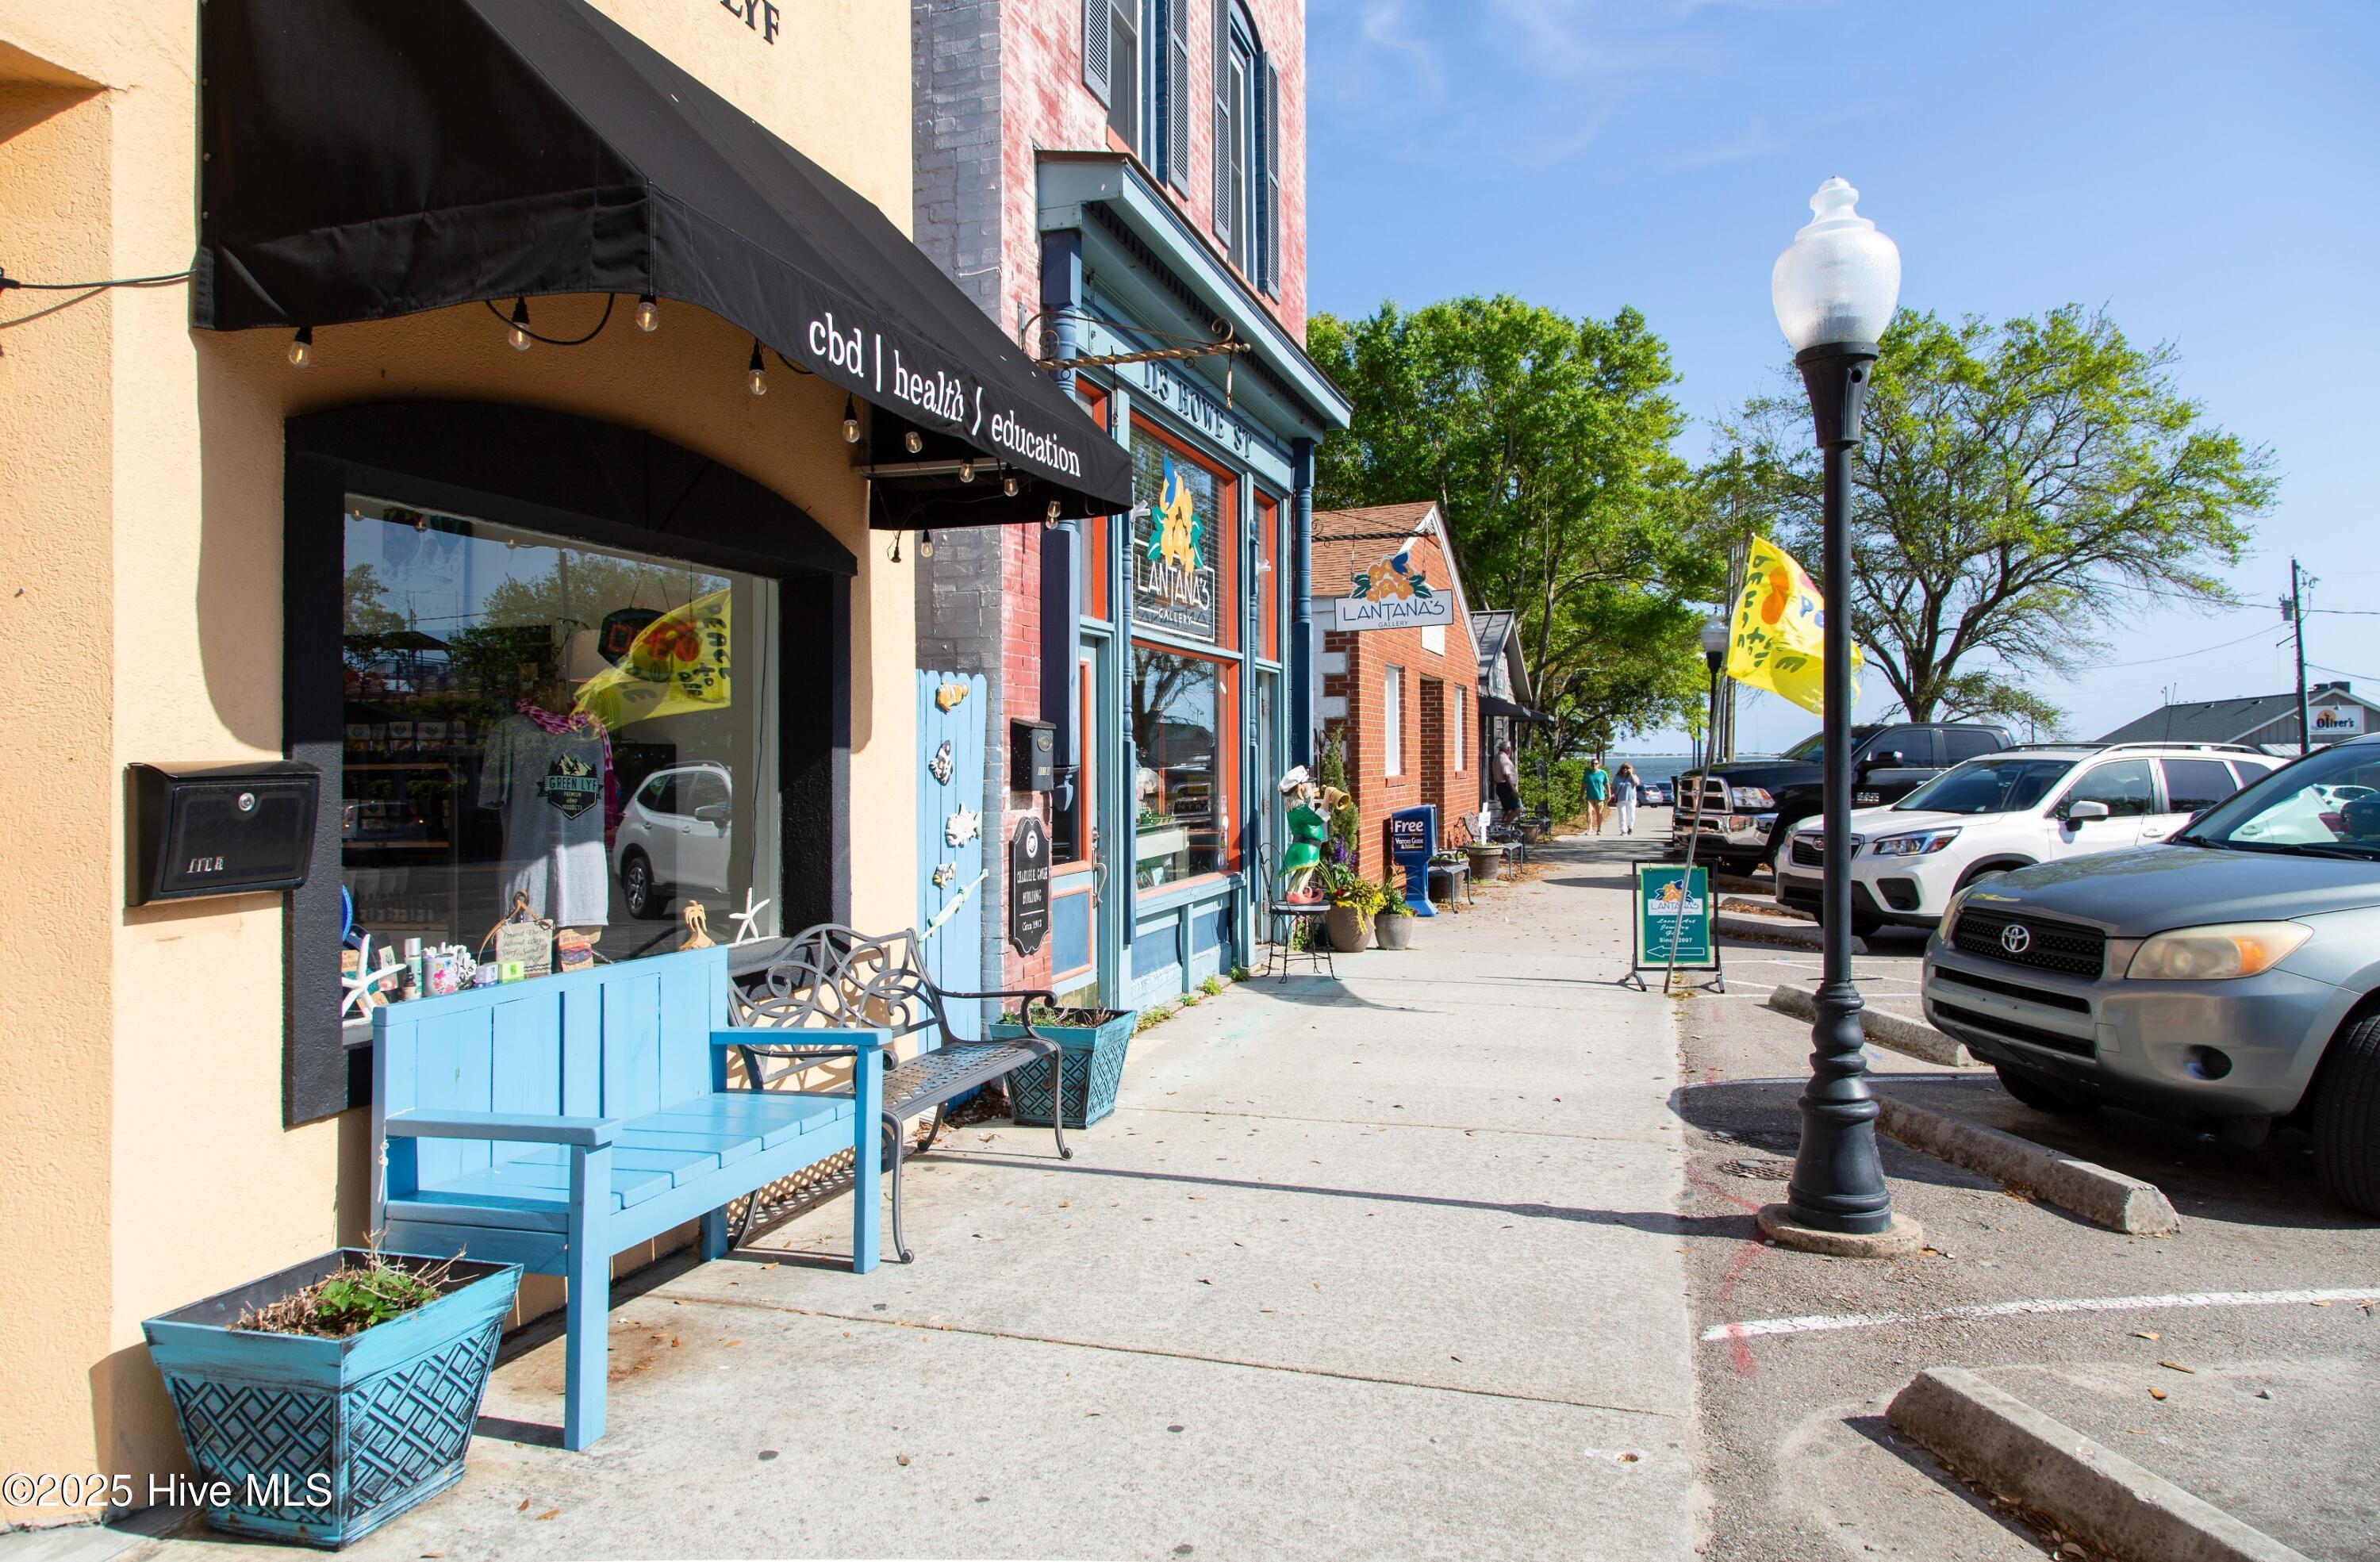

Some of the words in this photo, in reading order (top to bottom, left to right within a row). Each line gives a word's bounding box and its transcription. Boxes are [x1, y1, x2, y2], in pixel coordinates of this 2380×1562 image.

[809, 313, 864, 378] cbd
[894, 350, 965, 422] health
[992, 410, 1081, 478] education
[1177, 380, 1224, 439] HOWE
[1234, 424, 1252, 458] ST
[1138, 555, 1210, 611] LANTANA'S
[1158, 608, 1192, 625] GALLERY
[1343, 599, 1445, 621] LANTANA'S
[2316, 716, 2355, 728] Oliver's
[549, 777, 578, 789] GREEN
[581, 779, 597, 792] LYF
[1395, 820, 1424, 832] Free
[1022, 888, 1042, 905] BUILDING
[1022, 921, 1032, 931] Circa
